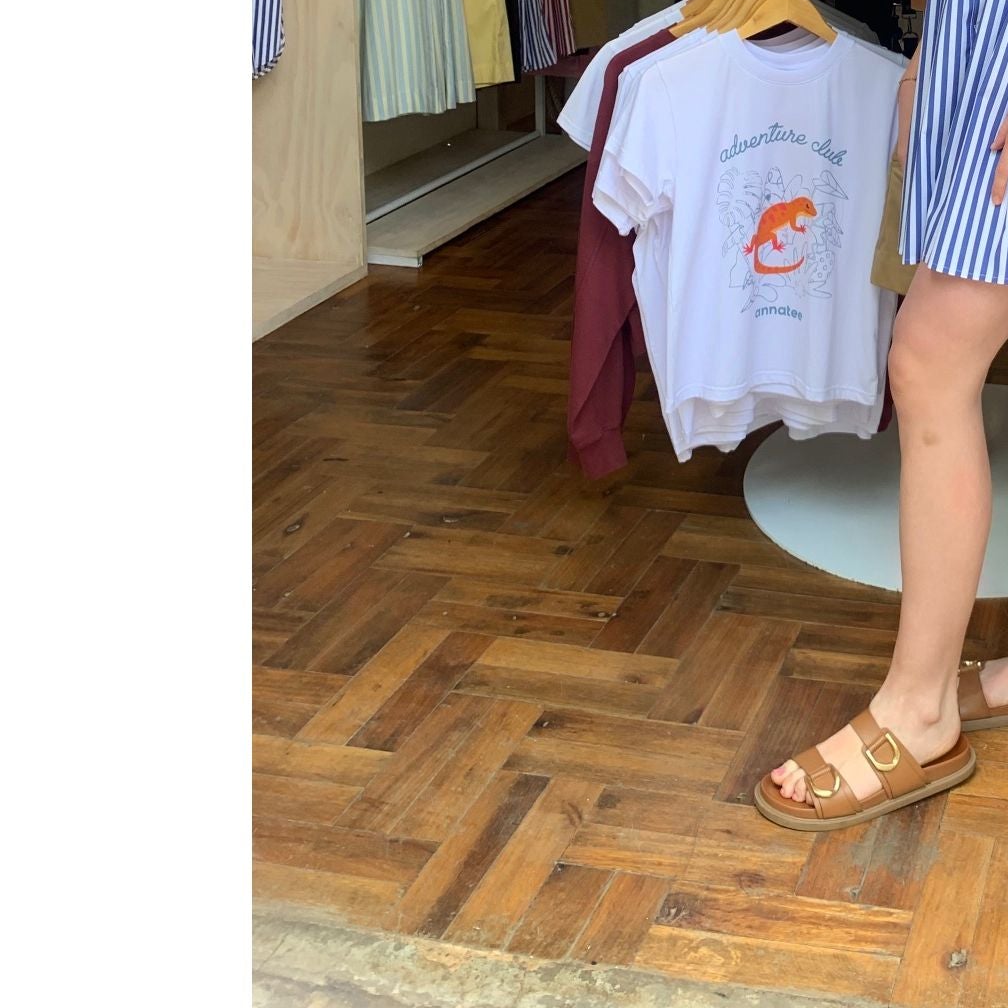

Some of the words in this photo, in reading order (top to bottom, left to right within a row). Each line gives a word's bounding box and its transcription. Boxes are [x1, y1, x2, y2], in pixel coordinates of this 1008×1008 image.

[719, 121, 809, 164] adventure
[811, 138, 848, 167] club
[754, 304, 803, 321] annatee
